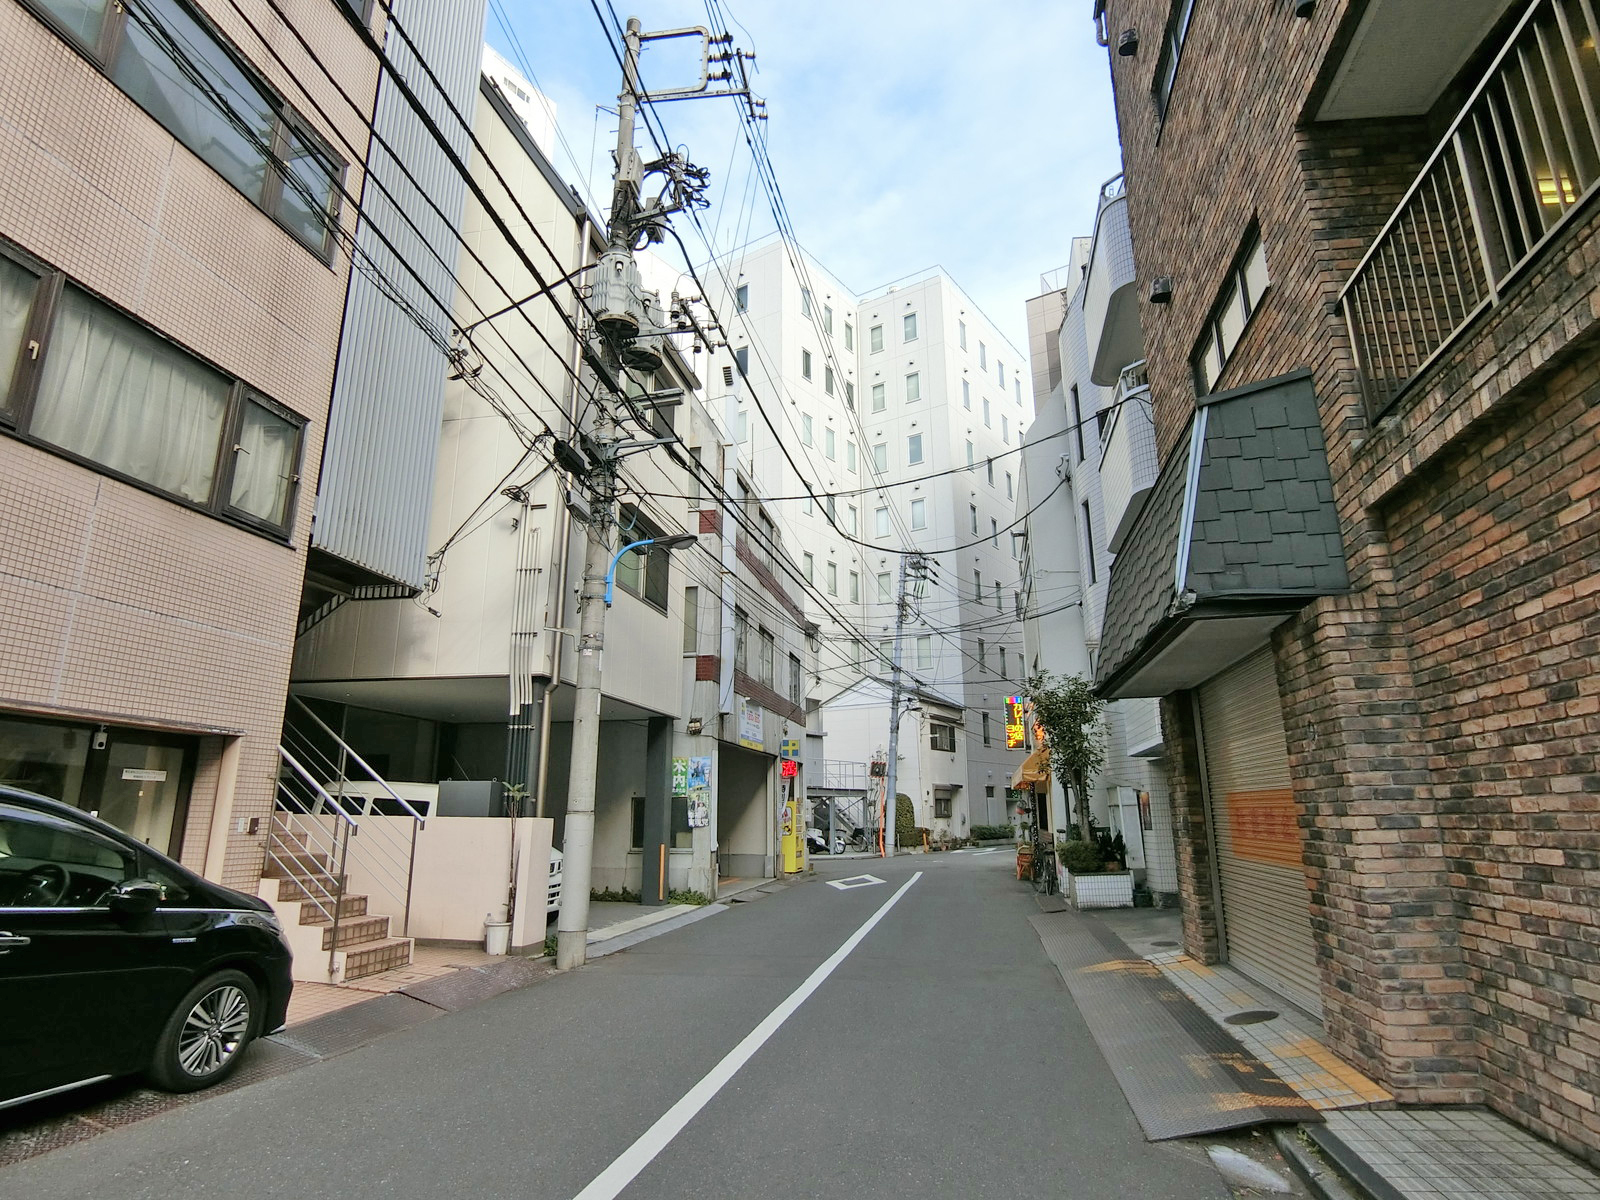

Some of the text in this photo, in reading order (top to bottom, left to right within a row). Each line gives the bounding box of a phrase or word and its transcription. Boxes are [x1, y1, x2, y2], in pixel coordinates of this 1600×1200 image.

[1013, 703, 1024, 740] カレーの店
[673, 760, 686, 788] 木内
[782, 761, 797, 776] 満
